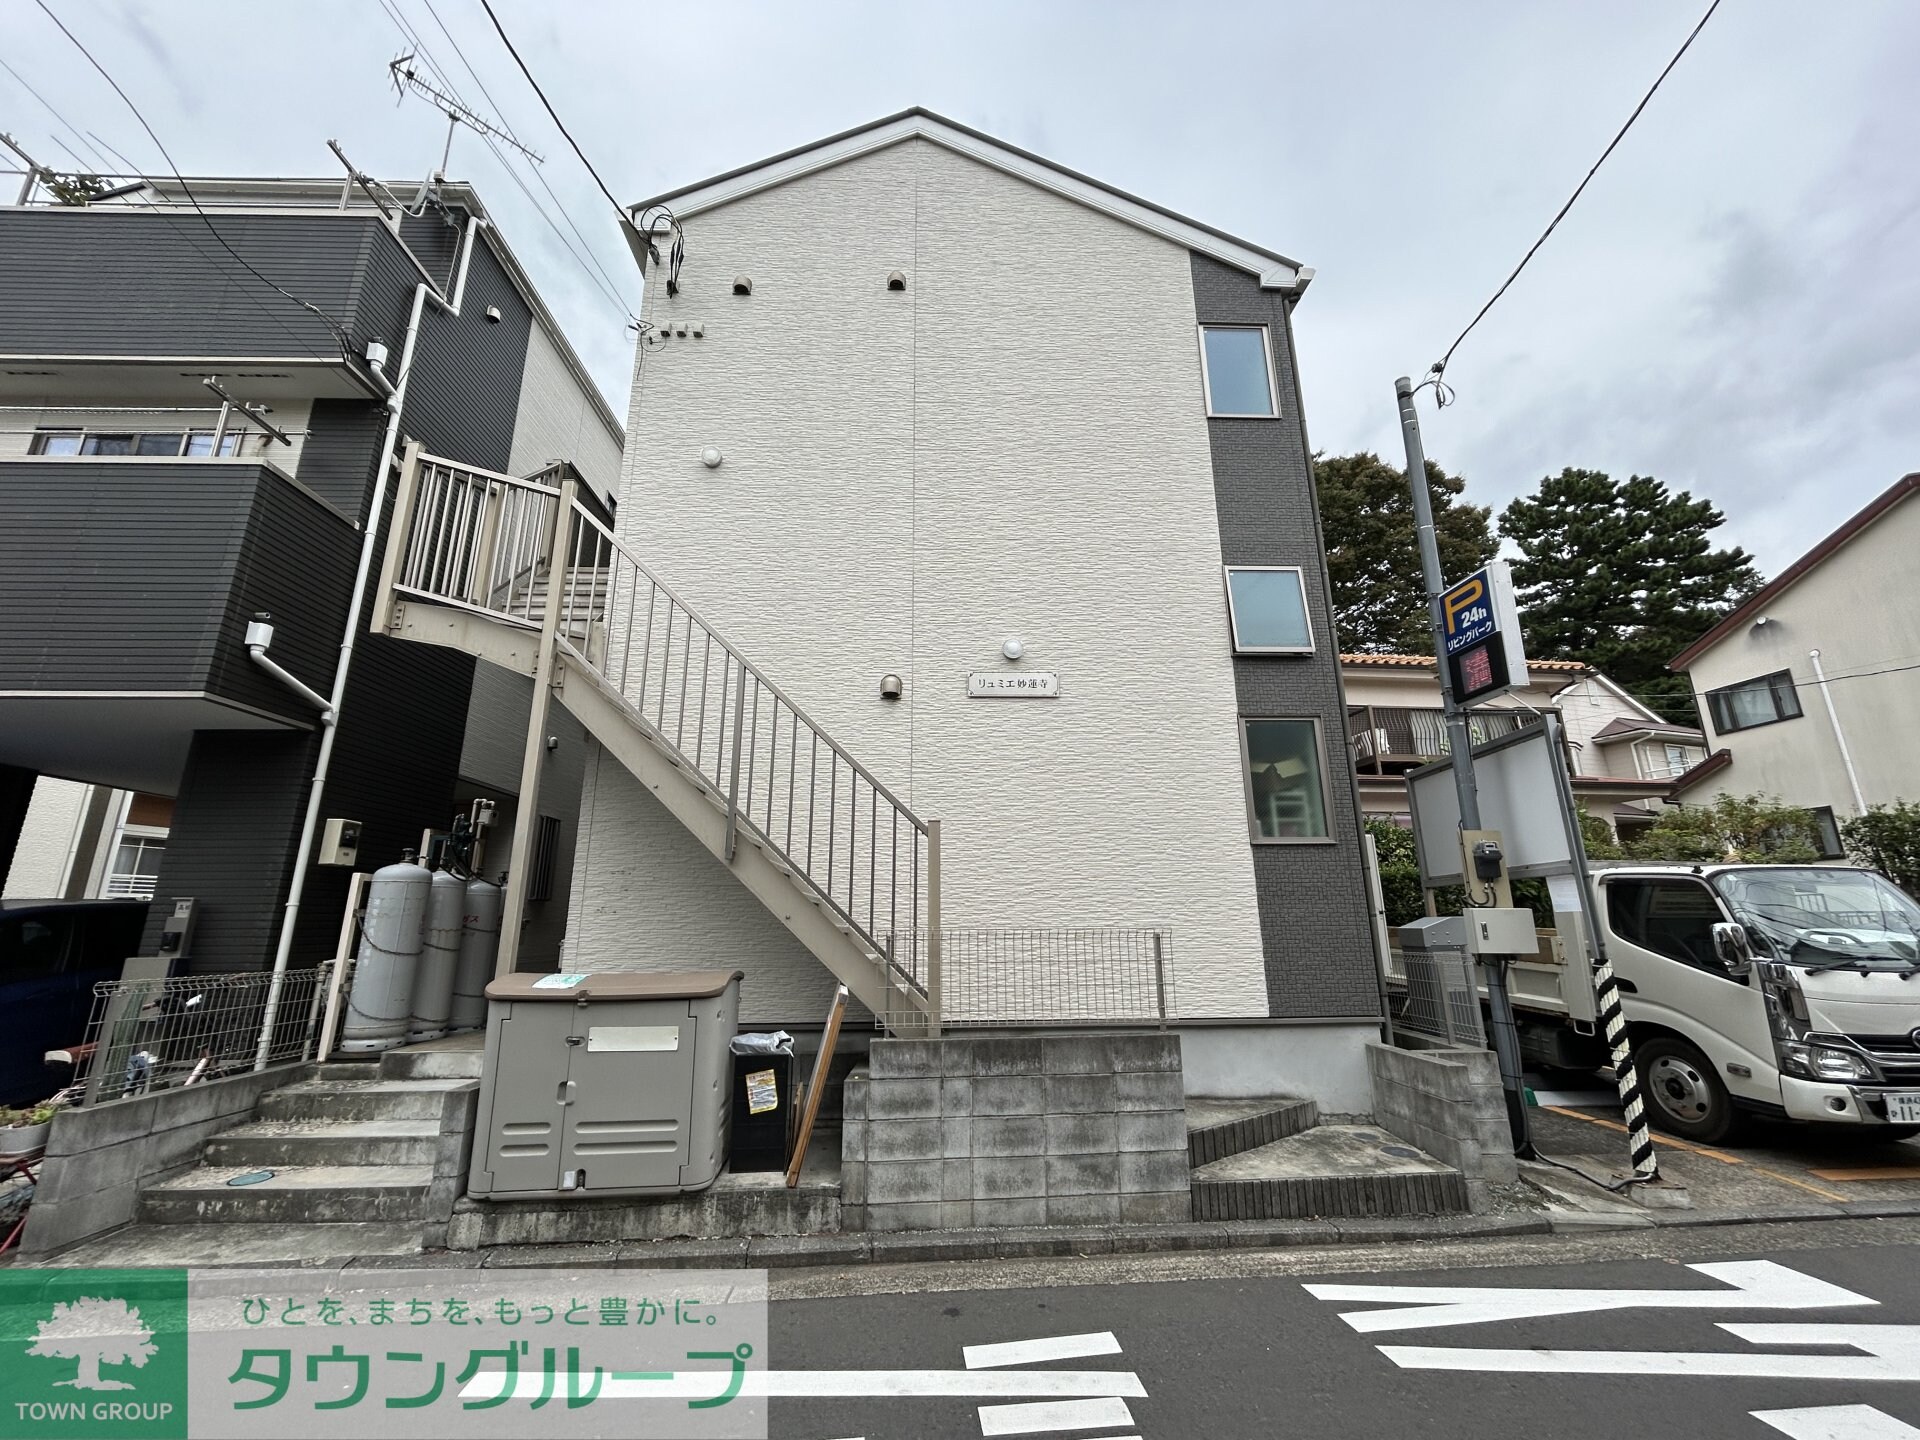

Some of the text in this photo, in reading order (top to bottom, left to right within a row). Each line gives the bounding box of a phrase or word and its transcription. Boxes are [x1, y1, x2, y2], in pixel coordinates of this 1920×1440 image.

[1445, 579, 1483, 635] P
[1461, 606, 1487, 628] 24h
[978, 678, 1048, 689] リュミエ妙蓮寺
